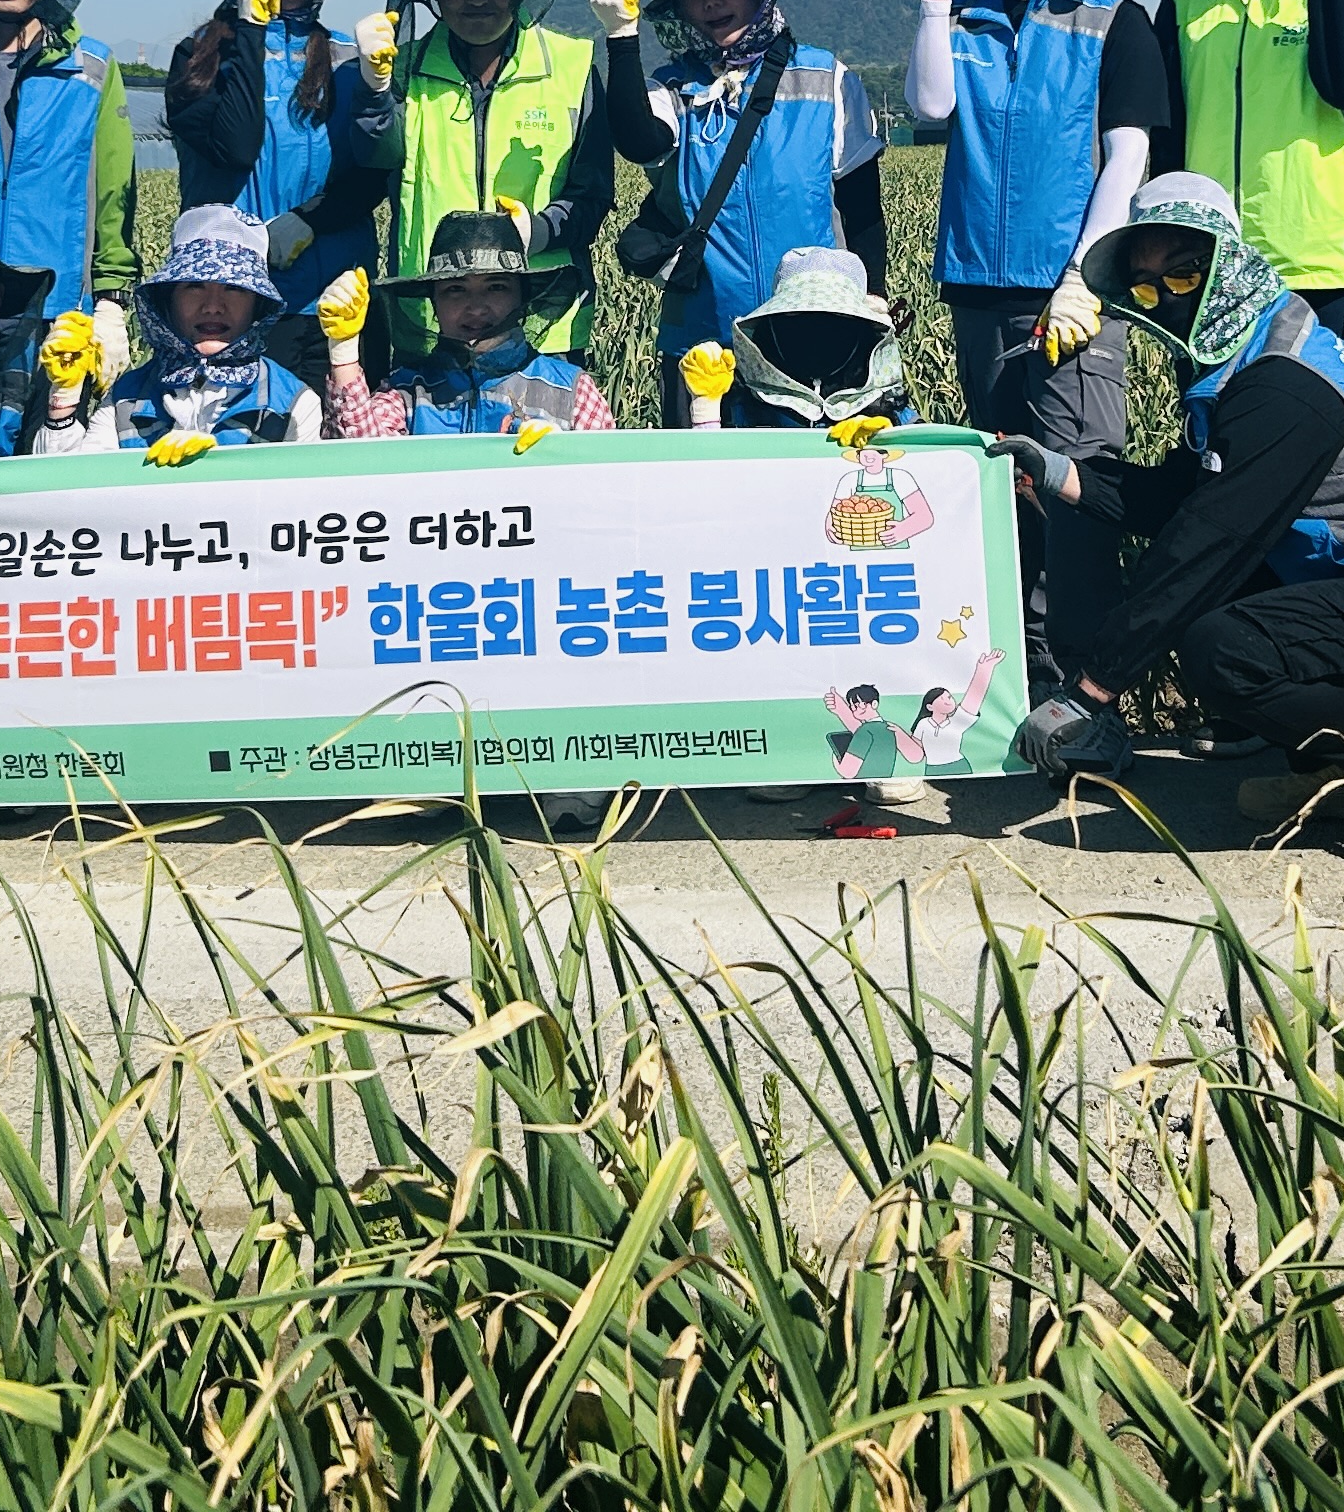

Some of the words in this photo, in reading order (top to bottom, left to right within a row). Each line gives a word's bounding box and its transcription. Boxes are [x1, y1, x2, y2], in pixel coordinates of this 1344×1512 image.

[120, 521, 249, 571] 나누고,
[270, 510, 390, 565] 마음은
[409, 504, 535, 551] 더하고
[367, 576, 537, 665] 한울회
[555, 569, 669, 657] 농촌
[687, 561, 921, 652] 봉사활동
[239, 746, 288, 773] 주관
[564, 728, 769, 763] 사회복지정보센터
